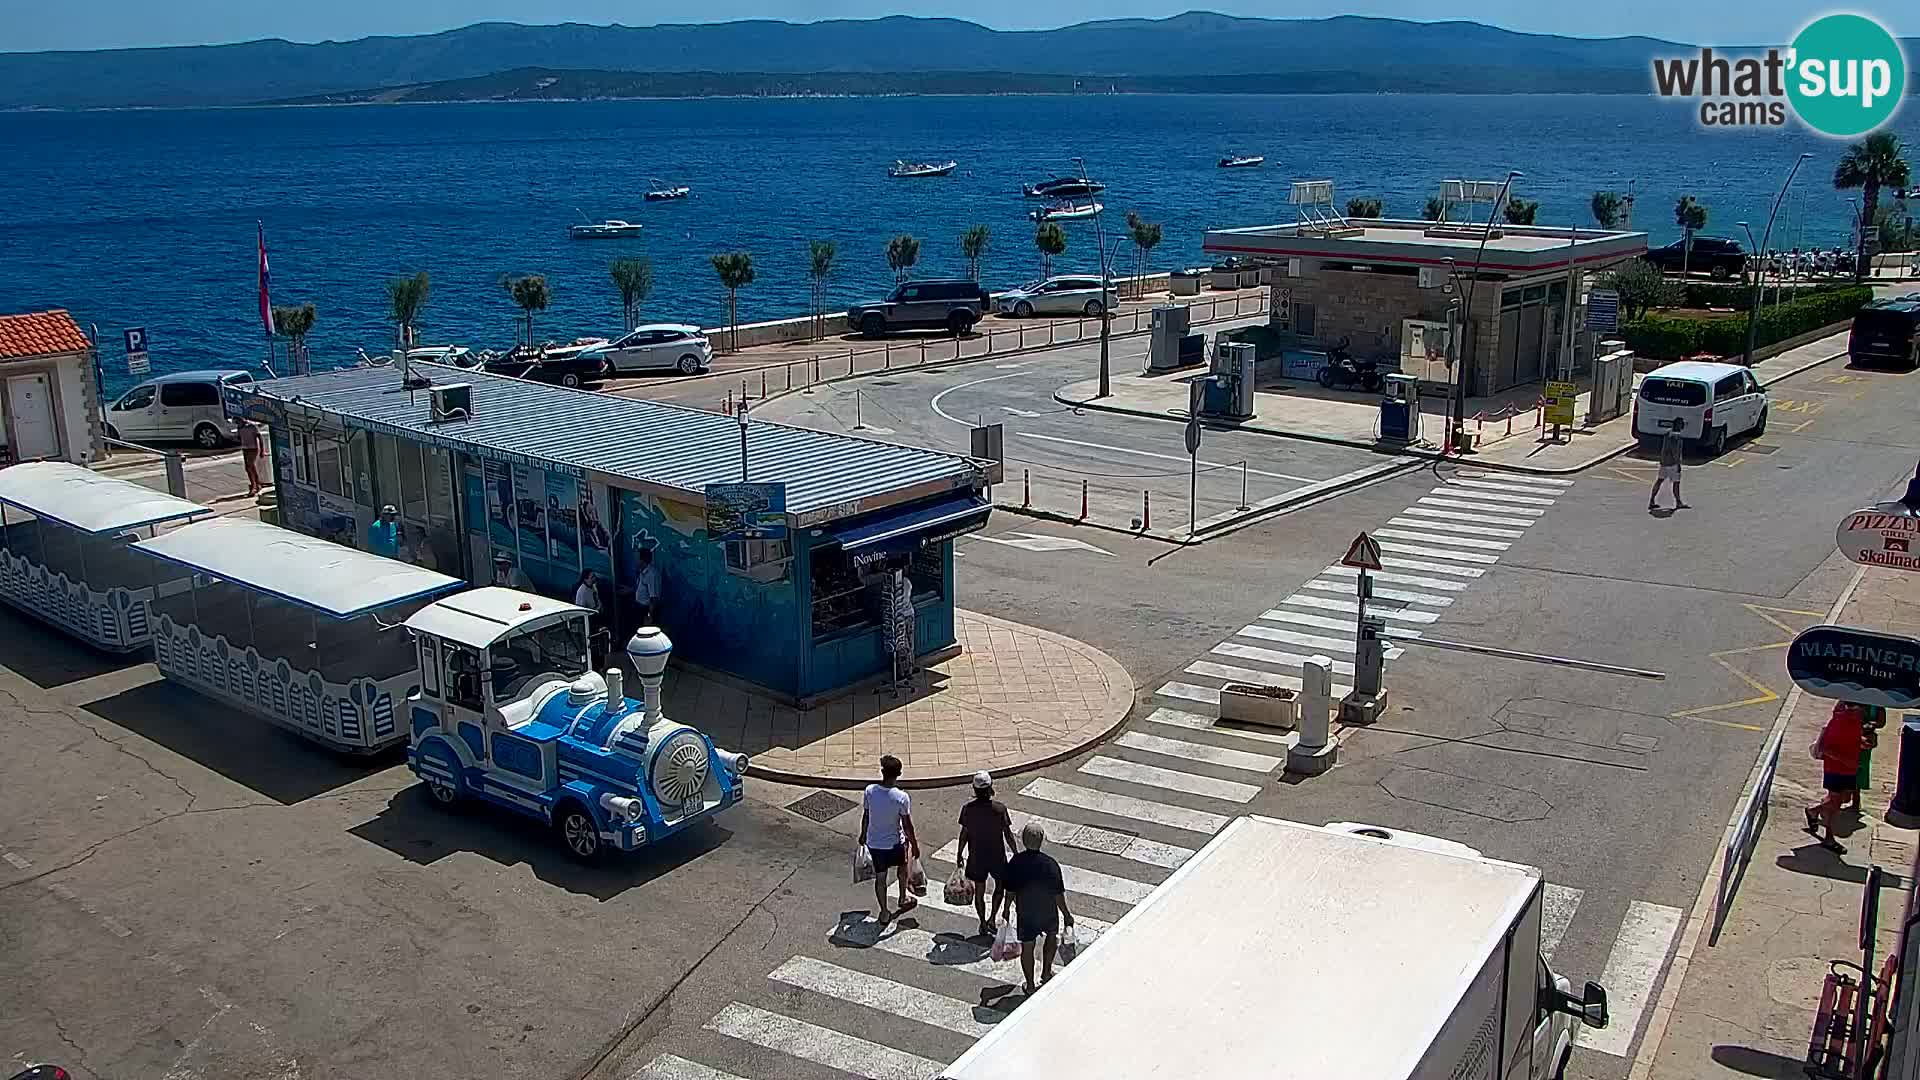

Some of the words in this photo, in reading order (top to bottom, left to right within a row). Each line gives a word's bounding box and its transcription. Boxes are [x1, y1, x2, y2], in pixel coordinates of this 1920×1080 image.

[128, 331, 141, 350] P
[494, 449, 526, 464] STATION
[527, 456, 554, 471] TICKET
[554, 462, 582, 477] OFFICE
[1848, 514, 1920, 534] PIZZE
